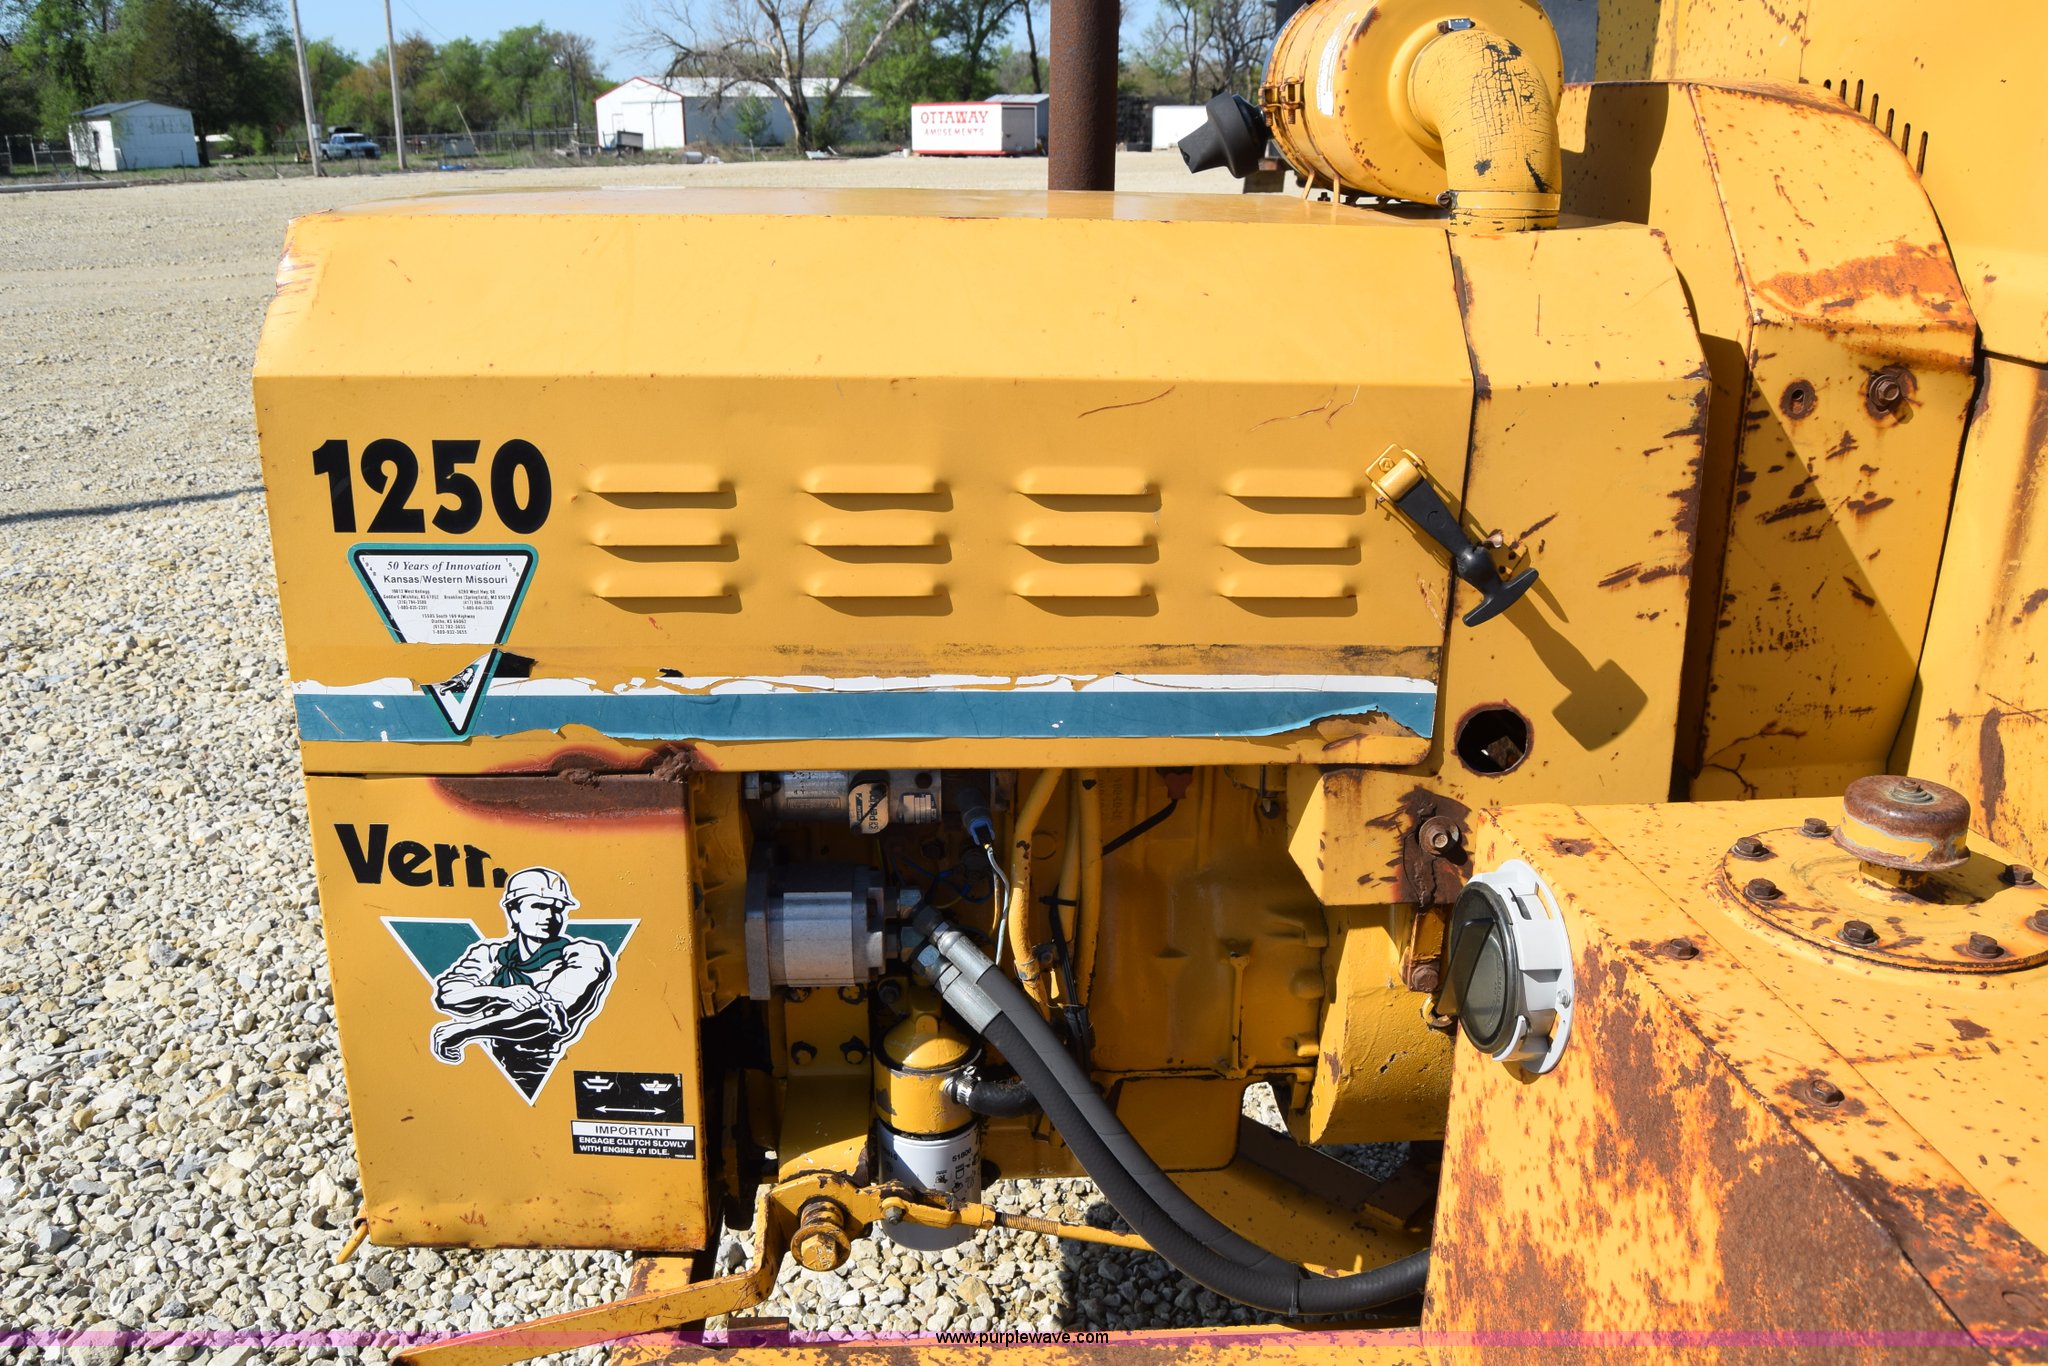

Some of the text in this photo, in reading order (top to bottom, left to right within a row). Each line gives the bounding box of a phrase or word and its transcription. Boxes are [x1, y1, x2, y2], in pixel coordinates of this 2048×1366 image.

[921, 110, 989, 124] OTTAWAY
[924, 127, 984, 136] AMUSEMENTS
[312, 438, 552, 535] 1250
[386, 561, 501, 573] 50 Years of Innovation
[383, 575, 508, 584] Kansas/Western Missouri
[595, 1125, 671, 1137] IMPORTANT
[579, 1137, 687, 1148] ENGAGE CLUTCH SLOWLY
[603, 1146, 634, 1154] ENGINE
[649, 1148, 670, 1156] IDLE.
